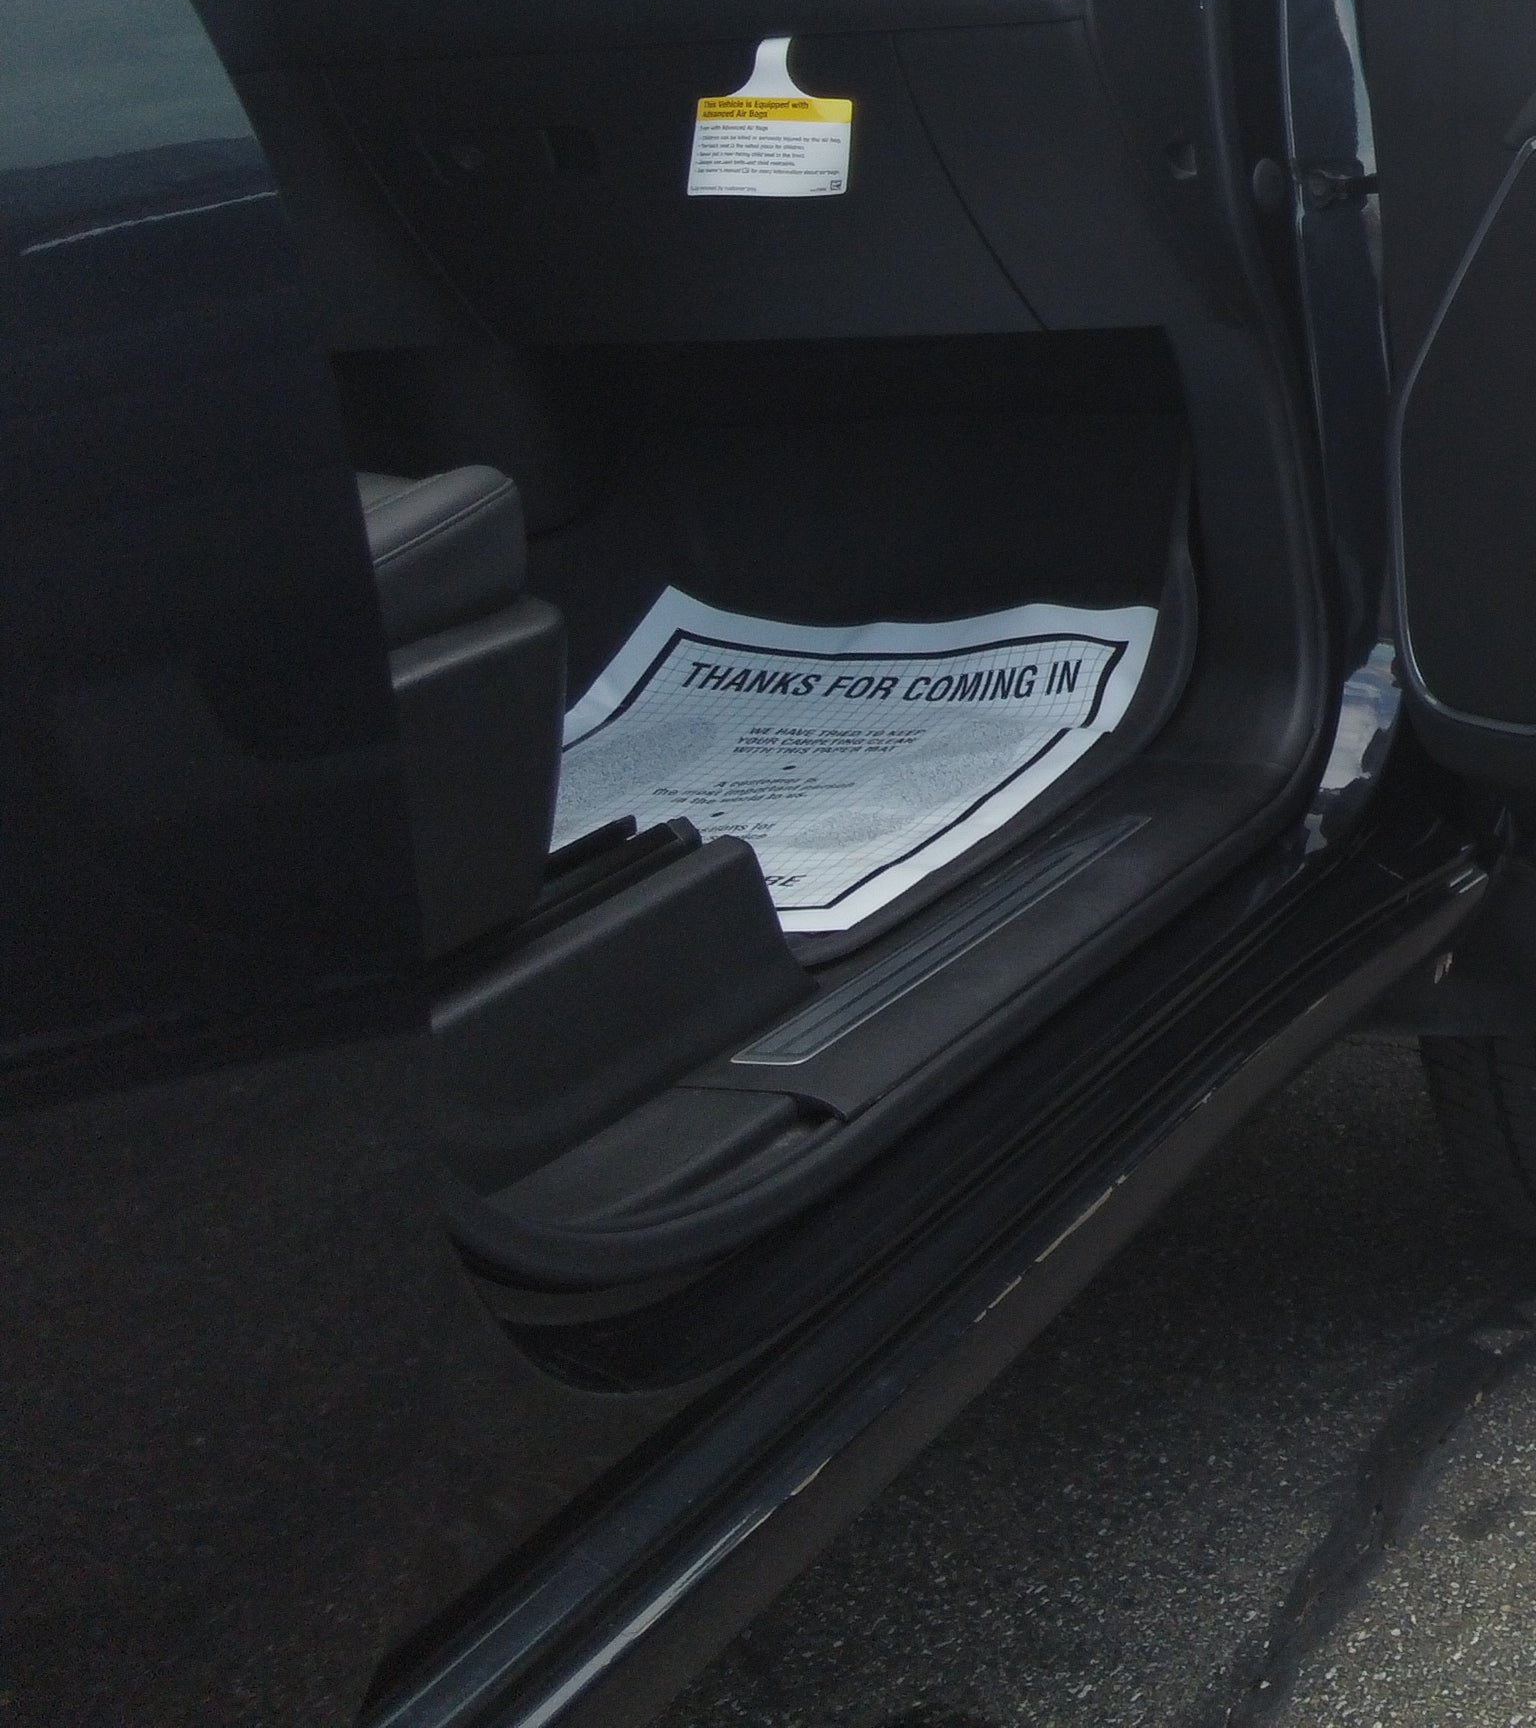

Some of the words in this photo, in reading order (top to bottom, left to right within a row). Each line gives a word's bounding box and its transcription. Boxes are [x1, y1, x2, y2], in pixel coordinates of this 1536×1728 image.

[719, 100, 744, 109] Vehicle
[754, 100, 790, 110] Equipped
[736, 109, 747, 118] Air
[749, 109, 768, 119] Bags
[681, 661, 822, 697] THANKS
[821, 675, 900, 700] FOR
[902, 663, 1039, 702] COMING
[1044, 658, 1083, 696] IN
[749, 726, 775, 735] WE
[775, 727, 817, 737] HAVE
[818, 729, 863, 737] TRIED
[864, 729, 886, 737] TO
[886, 728, 927, 737] KEEP
[737, 736, 780, 746] YOUR
[780, 737, 865, 747] CARPETING
[866, 736, 918, 746] CLEAN
[732, 745, 774, 754] WITH
[775, 745, 811, 754] THIS
[811, 745, 862, 754] PAPER
[863, 744, 898, 754] MAT
[750, 822, 777, 831] for
